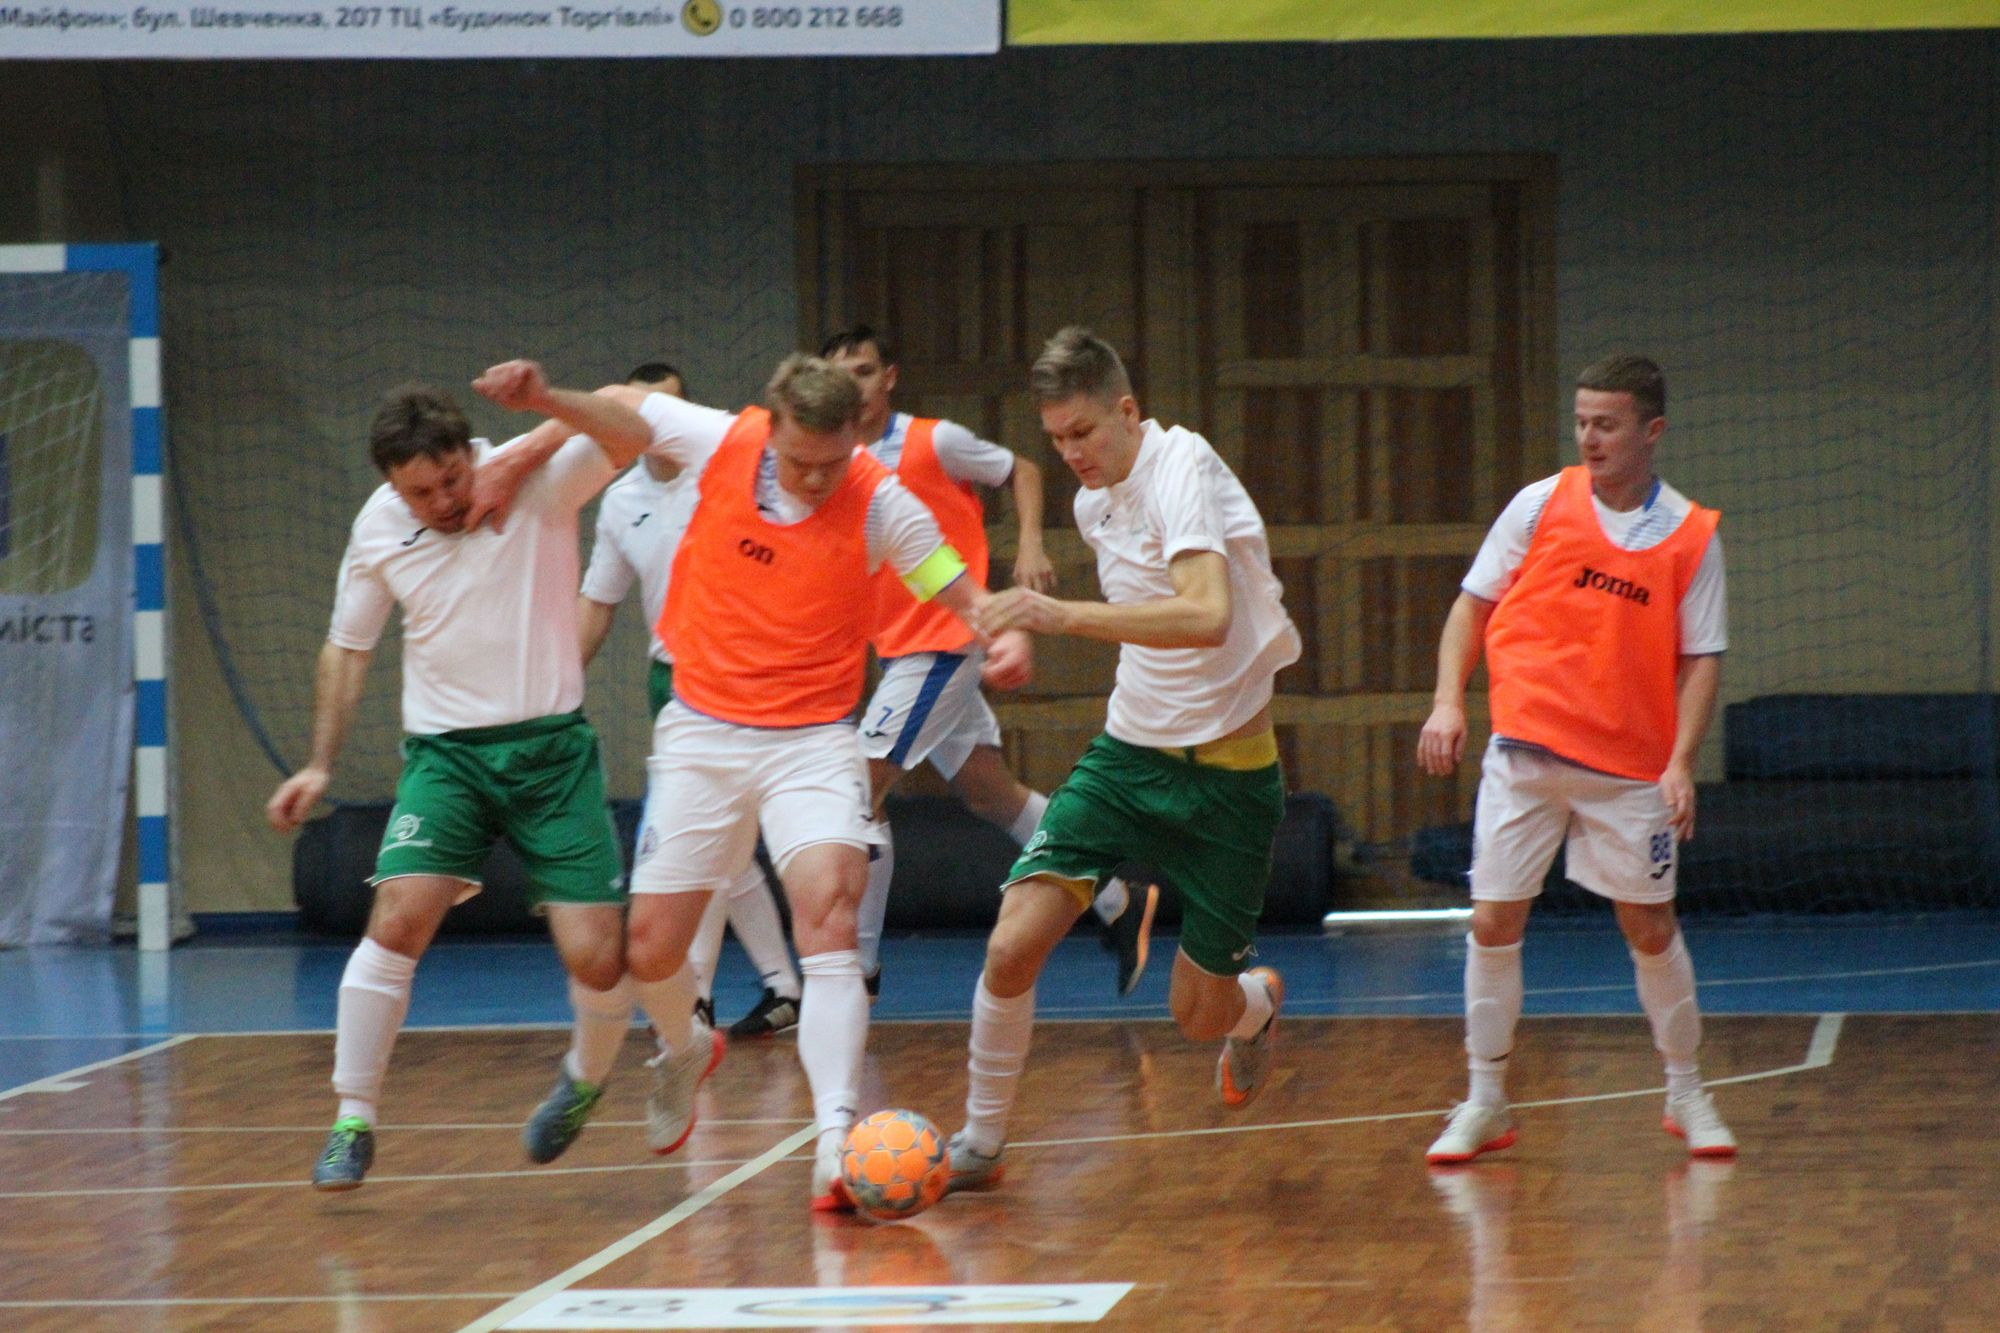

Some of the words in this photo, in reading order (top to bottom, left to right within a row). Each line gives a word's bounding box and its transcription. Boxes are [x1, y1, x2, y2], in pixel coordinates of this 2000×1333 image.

[132, 7, 187, 33] бул.
[336, 6, 382, 28] 207
[388, 7, 424, 30] ТЦ
[729, 7, 746, 29] 0
[752, 7, 801, 29] 800
[808, 7, 849, 28] 212
[855, 6, 903, 28] 668
[1573, 567, 1650, 607] Joma
[876, 705, 893, 728] 7
